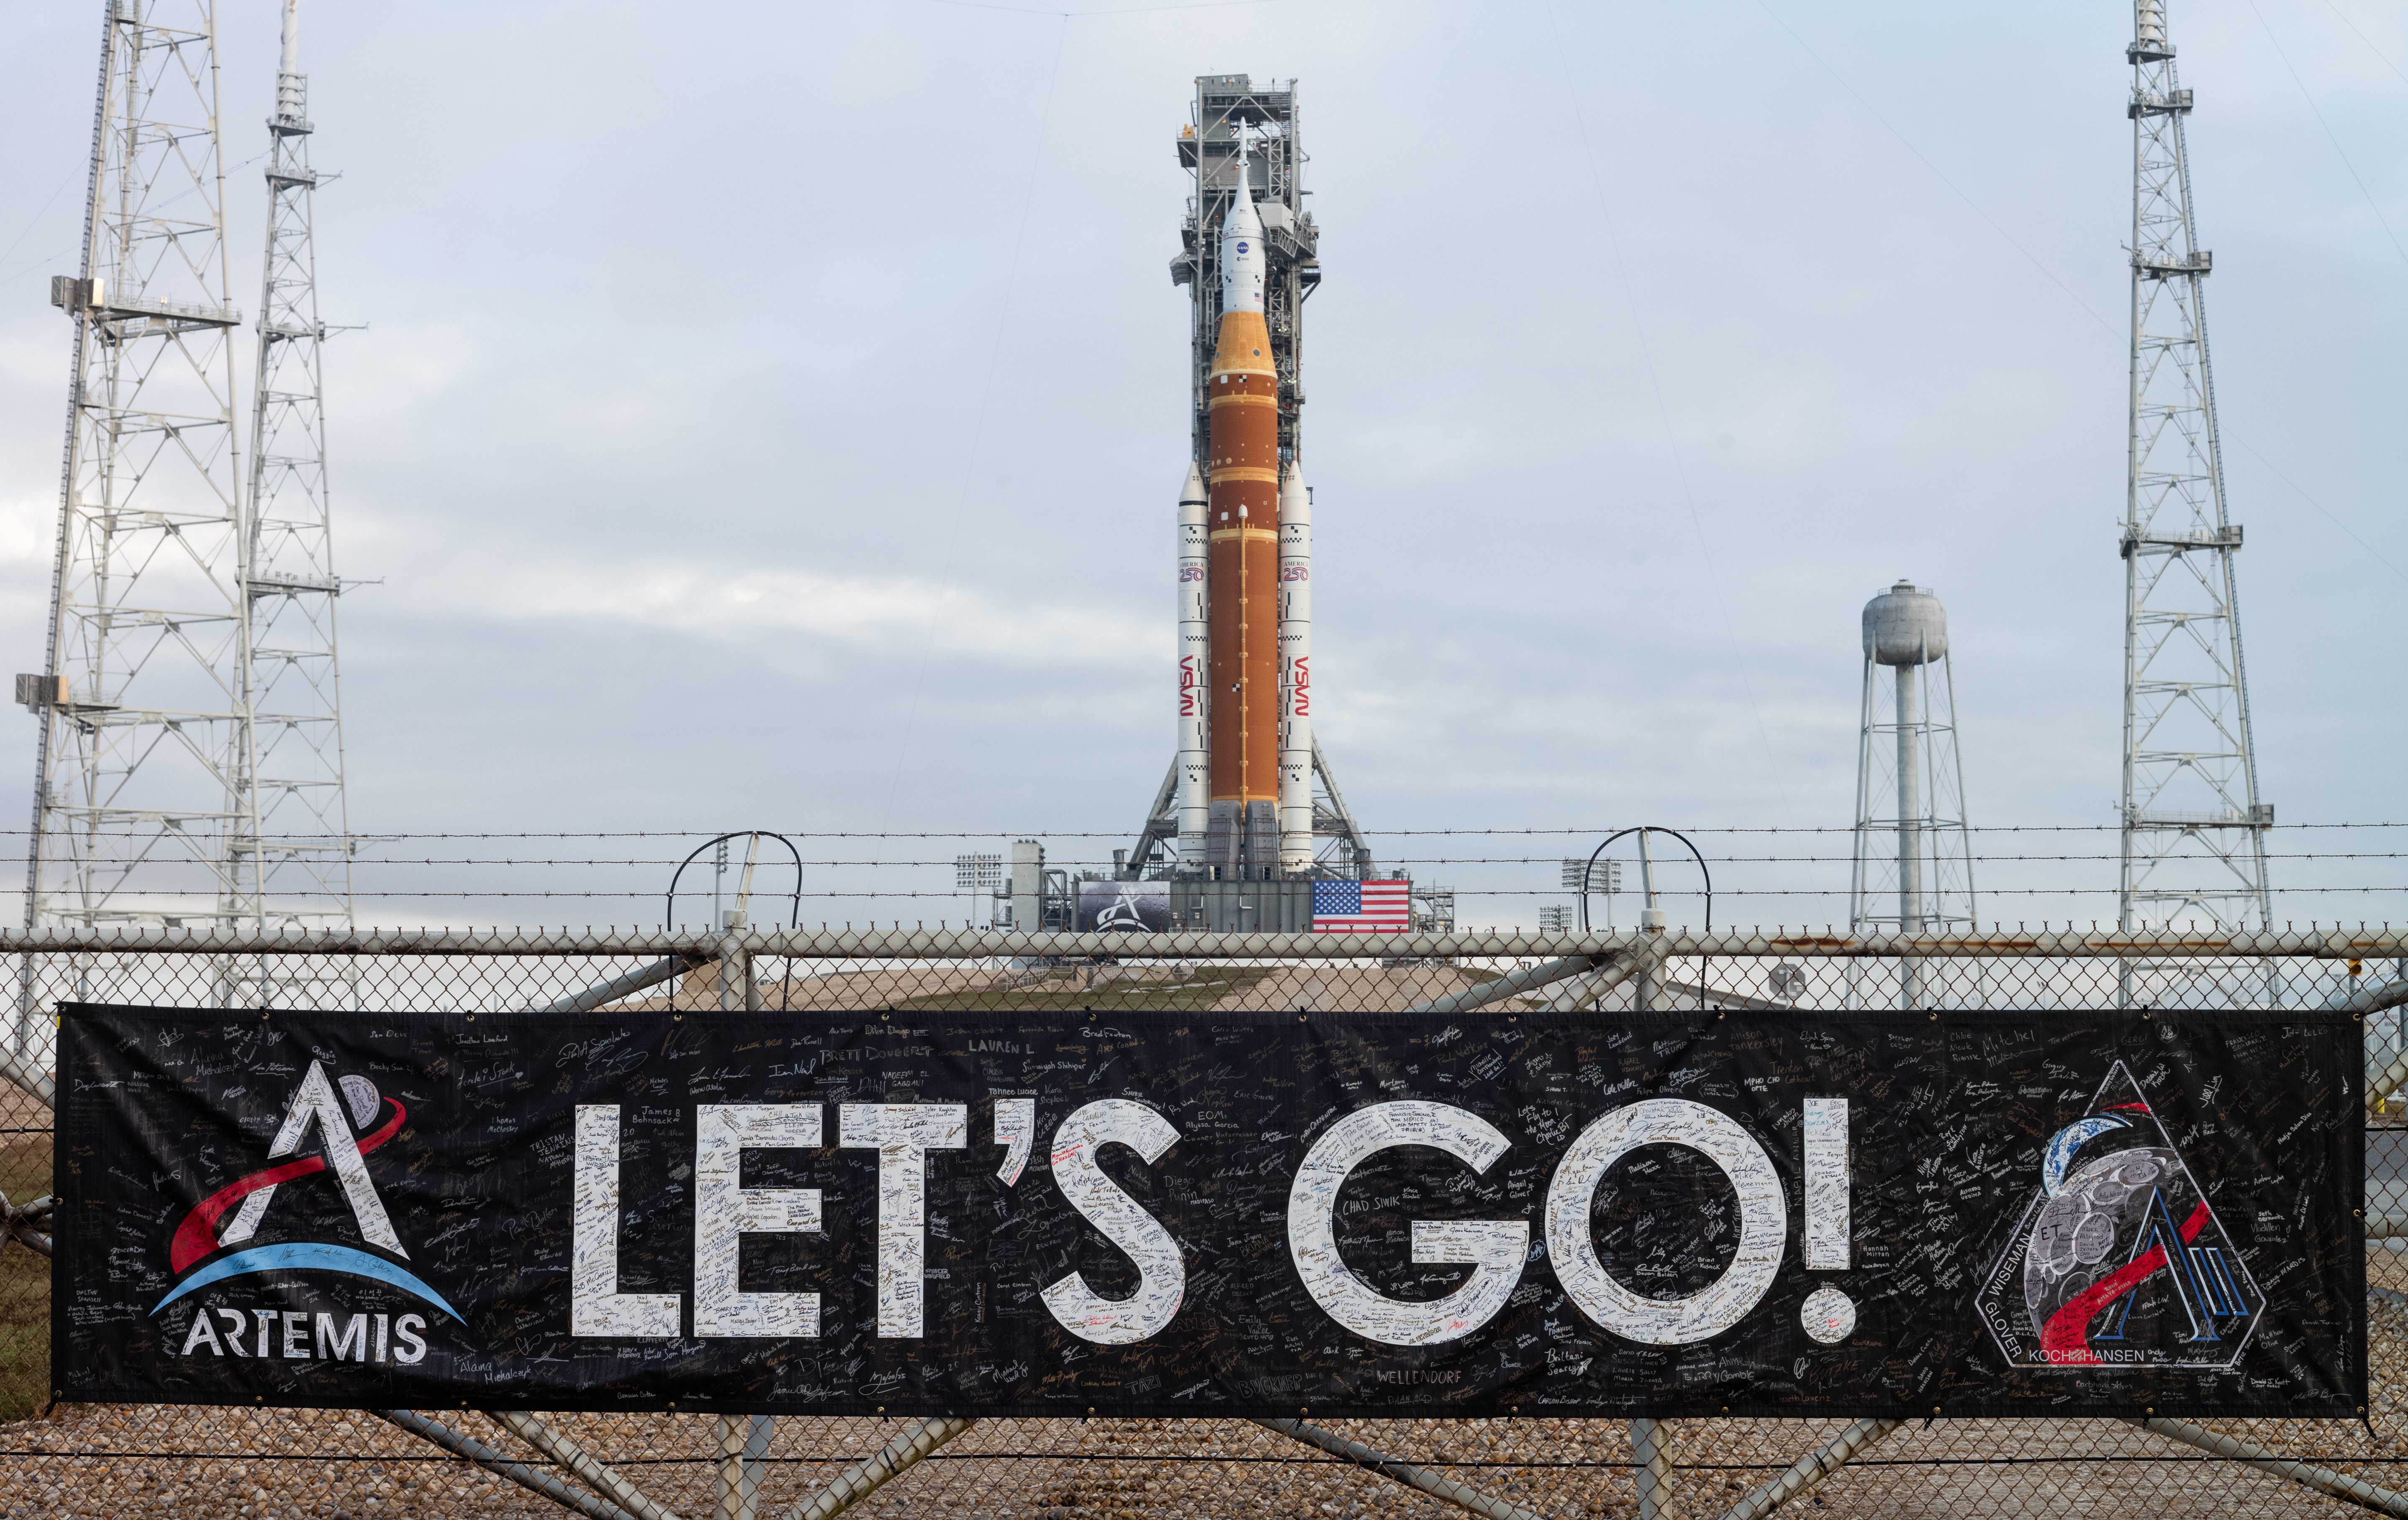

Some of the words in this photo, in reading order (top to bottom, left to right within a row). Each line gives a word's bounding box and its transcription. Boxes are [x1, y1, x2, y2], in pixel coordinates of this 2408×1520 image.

[1180, 567, 1204, 582] 250
[1284, 567, 1308, 581] 250
[1180, 655, 1194, 716] NASA
[1295, 656, 1309, 716] NASA
[1080, 1027, 1103, 1038] Brad
[1104, 1028, 1131, 1038] Fenton
[1730, 1030, 1762, 1040] Allison
[1950, 1032, 1972, 1040] Chloe
[969, 1040, 1019, 1053] LAUREN
[1950, 1043, 1973, 1052] Nicole
[820, 1048, 862, 1062] BRETT
[1953, 1053, 1981, 1062] Rianne
[370, 1062, 389, 1071] Becky
[1057, 1061, 1086, 1071] Shihipar
[1769, 1061, 1802, 1076] Trenton
[892, 1079, 924, 1088] GABBANI
[1785, 1074, 1816, 1084] Cathcart
[1045, 1084, 1062, 1094] Kara
[1122, 1087, 1144, 1097] SHERYL
[1637, 1087, 1654, 1095] Felipe
[1660, 1086, 1683, 1094] Oliveira
[1039, 1095, 1069, 1105] Sheplock
[2199, 1086, 2214, 1109] Jill
[1135, 1096, 1165, 1112] SANDRIDGE!
[641, 1106, 667, 1115] James
[1198, 1111, 1227, 1121] EOMs
[1517, 1105, 1535, 1117] Lets
[632, 1115, 673, 1124] Bohnsack
[1527, 1114, 1541, 1123] Fly
[1185, 1121, 1211, 1131] Alyssa
[1524, 1125, 1538, 1135] the
[316, 1125, 329, 1145] TIFFANY
[529, 1133, 565, 1151] TRISTAN
[539, 1136, 576, 1156] JENKINS
[1146, 1144, 1166, 1164] Michann
[1163, 1133, 1180, 1149] Wernli
[322, 1142, 335, 1168] WARDLOW
[1360, 1165, 1392, 1178] MARTINEZ
[1948, 1170, 1967, 1181] CZECH
[1164, 1176, 1195, 1188] Diego
[1794, 1167, 1803, 1206] NABIL
[1169, 1189, 1198, 1201] Punín
[1509, 1190, 1531, 1199] Glover
[1960, 1186, 1981, 1194] ALFREDO
[1961, 1191, 1981, 1200] URBINA
[1343, 1199, 1369, 1215] CHAD
[1373, 1196, 1400, 1210] SIWIK
[570, 1101, 1189, 1346] LET'S
[703, 1217, 721, 1231] Jordan
[1286, 1095, 1859, 1348] GO!
[701, 1225, 726, 1240] Fahringer
[2041, 1224, 2063, 1241] ET
[1720, 1246, 1737, 1255] Garcia
[1989, 1232, 2031, 1297] WISEMAN
[2280, 1256, 2306, 1276] MARDIS
[1689, 1286, 1714, 1304] BRITTANY
[1716, 1271, 1731, 1289] STONE
[1641, 1298, 1664, 1310] Thomas
[1664, 1302, 1686, 1310] Fraley
[515, 1312, 539, 1323] Christian
[516, 1316, 546, 1330] Warriner
[1238, 1315, 1262, 1325] Emily
[181, 1307, 427, 1363] ARTEMIS
[1985, 1302, 2022, 1358] GLOVER
[2259, 1328, 2284, 1341] Matthew
[2261, 1339, 2278, 1349] Olive
[1545, 1349, 1584, 1363] Brittani
[2029, 1350, 2071, 1361] KOCH
[2088, 1350, 2144, 1361] HANSEN
[460, 1362, 492, 1373] Alaina
[1087, 1363, 1108, 1373] Jacob
[1109, 1365, 1127, 1375] Walls
[1377, 1370, 1461, 1385] WELLENDORF
[1918, 1371, 1933, 1393] HARRISON
[1125, 1375, 1162, 1394] TAZI
[1238, 1374, 1302, 1399] BUCKNER
[767, 1382, 796, 1401] Jamie
[1538, 1395, 1560, 1404] CARSON
[1772, 1394, 1800, 1403] Lizzeth
